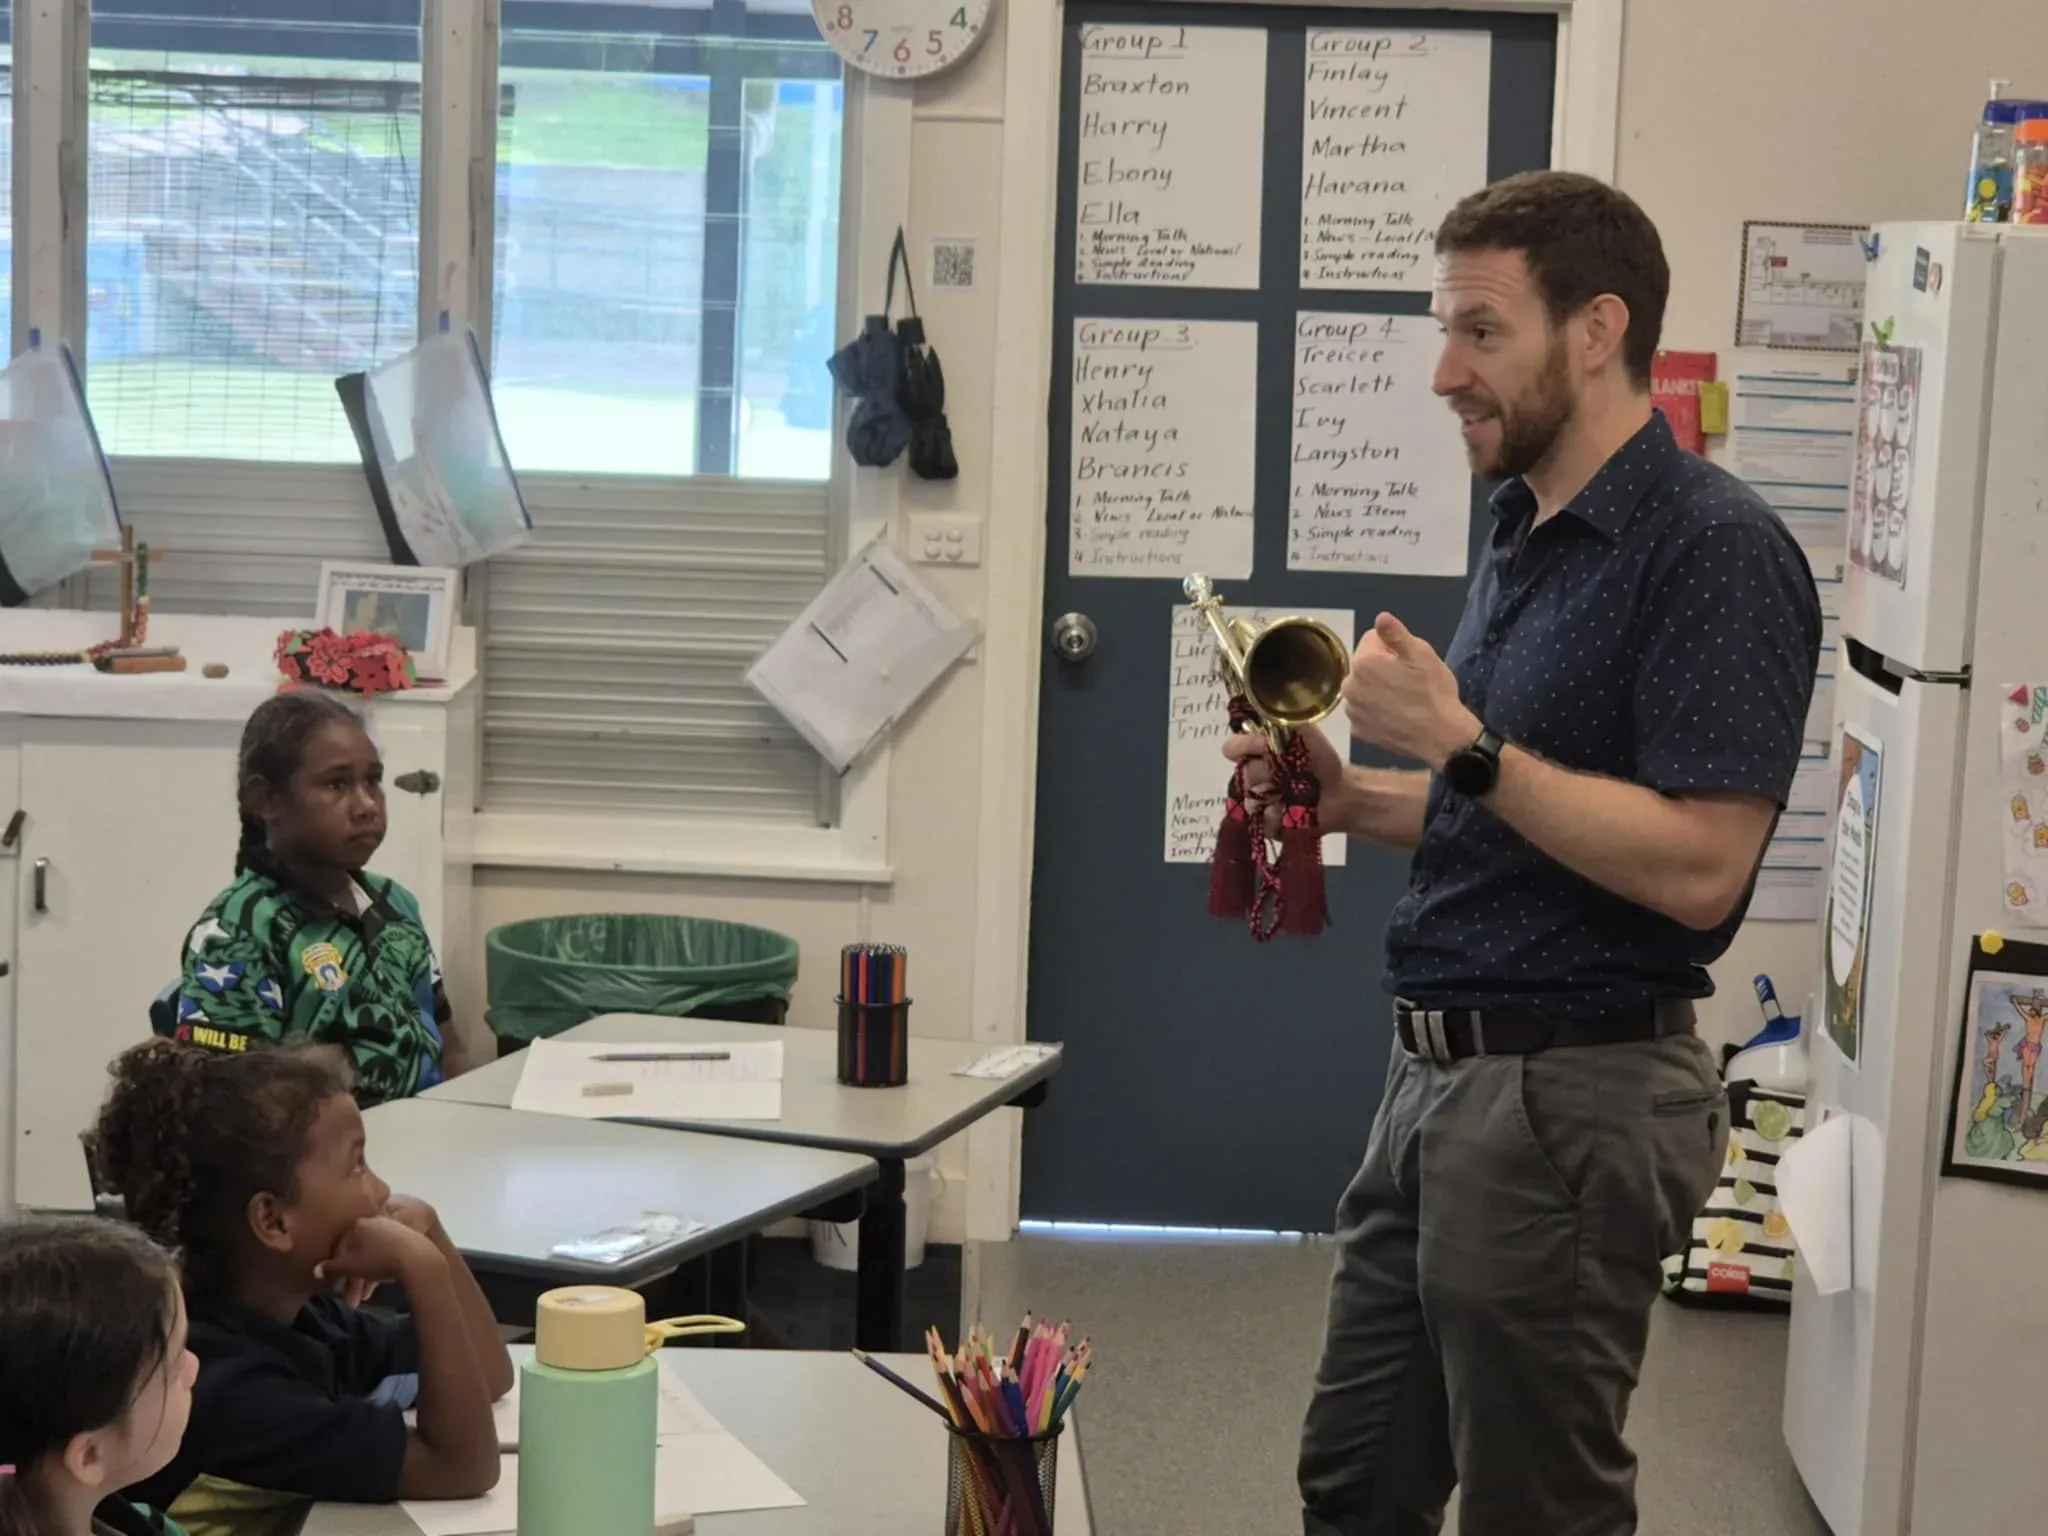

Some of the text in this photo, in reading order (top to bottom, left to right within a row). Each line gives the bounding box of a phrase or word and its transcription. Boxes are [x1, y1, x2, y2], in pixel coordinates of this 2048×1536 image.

[837, 5, 853, 30] 8
[950, 6, 968, 30] 4
[862, 29, 879, 52] 7
[894, 38, 911, 62] 6
[925, 30, 943, 55] 5
[1082, 27, 1188, 58] Group 1
[1310, 29, 1428, 61] Group 2
[1083, 73, 1190, 95] Braxton
[1308, 61, 1388, 93] Finlay
[1310, 93, 1409, 120] Vincent
[1082, 111, 1168, 151] Harry
[1311, 134, 1406, 158] Martha
[1083, 157, 1173, 190] Ebony
[1304, 171, 1406, 199] Havana
[1080, 201, 1141, 225] Ella
[1318, 213, 1375, 230] Morning
[1383, 212, 1413, 226] Talk
[1092, 230, 1149, 246] Morning
[1361, 248, 1419, 267] reading
[1080, 322, 1190, 351] Group 3
[1298, 315, 1399, 344] Group 4
[1076, 354, 1154, 391] Henry
[1296, 375, 1395, 396] Scarlett
[1081, 389, 1167, 415] Xhalia
[1296, 407, 1346, 437] Ivy
[1081, 419, 1179, 451] Nataya
[1294, 440, 1399, 470] Langston
[1093, 490, 1152, 509] Morning
[1157, 488, 1191, 503] Talk
[1311, 482, 1380, 502] Morning
[1384, 481, 1418, 498] Talk
[1314, 502, 1352, 519] News
[1362, 504, 1406, 519] Item
[1139, 528, 1190, 545] reading
[1306, 525, 1353, 544] Simple
[1360, 525, 1421, 545] reading
[1087, 547, 1183, 565] Instructions
[1172, 792, 1226, 812] Morni
[193, 1025, 226, 1049] WILL
[229, 1033, 248, 1051] BE
